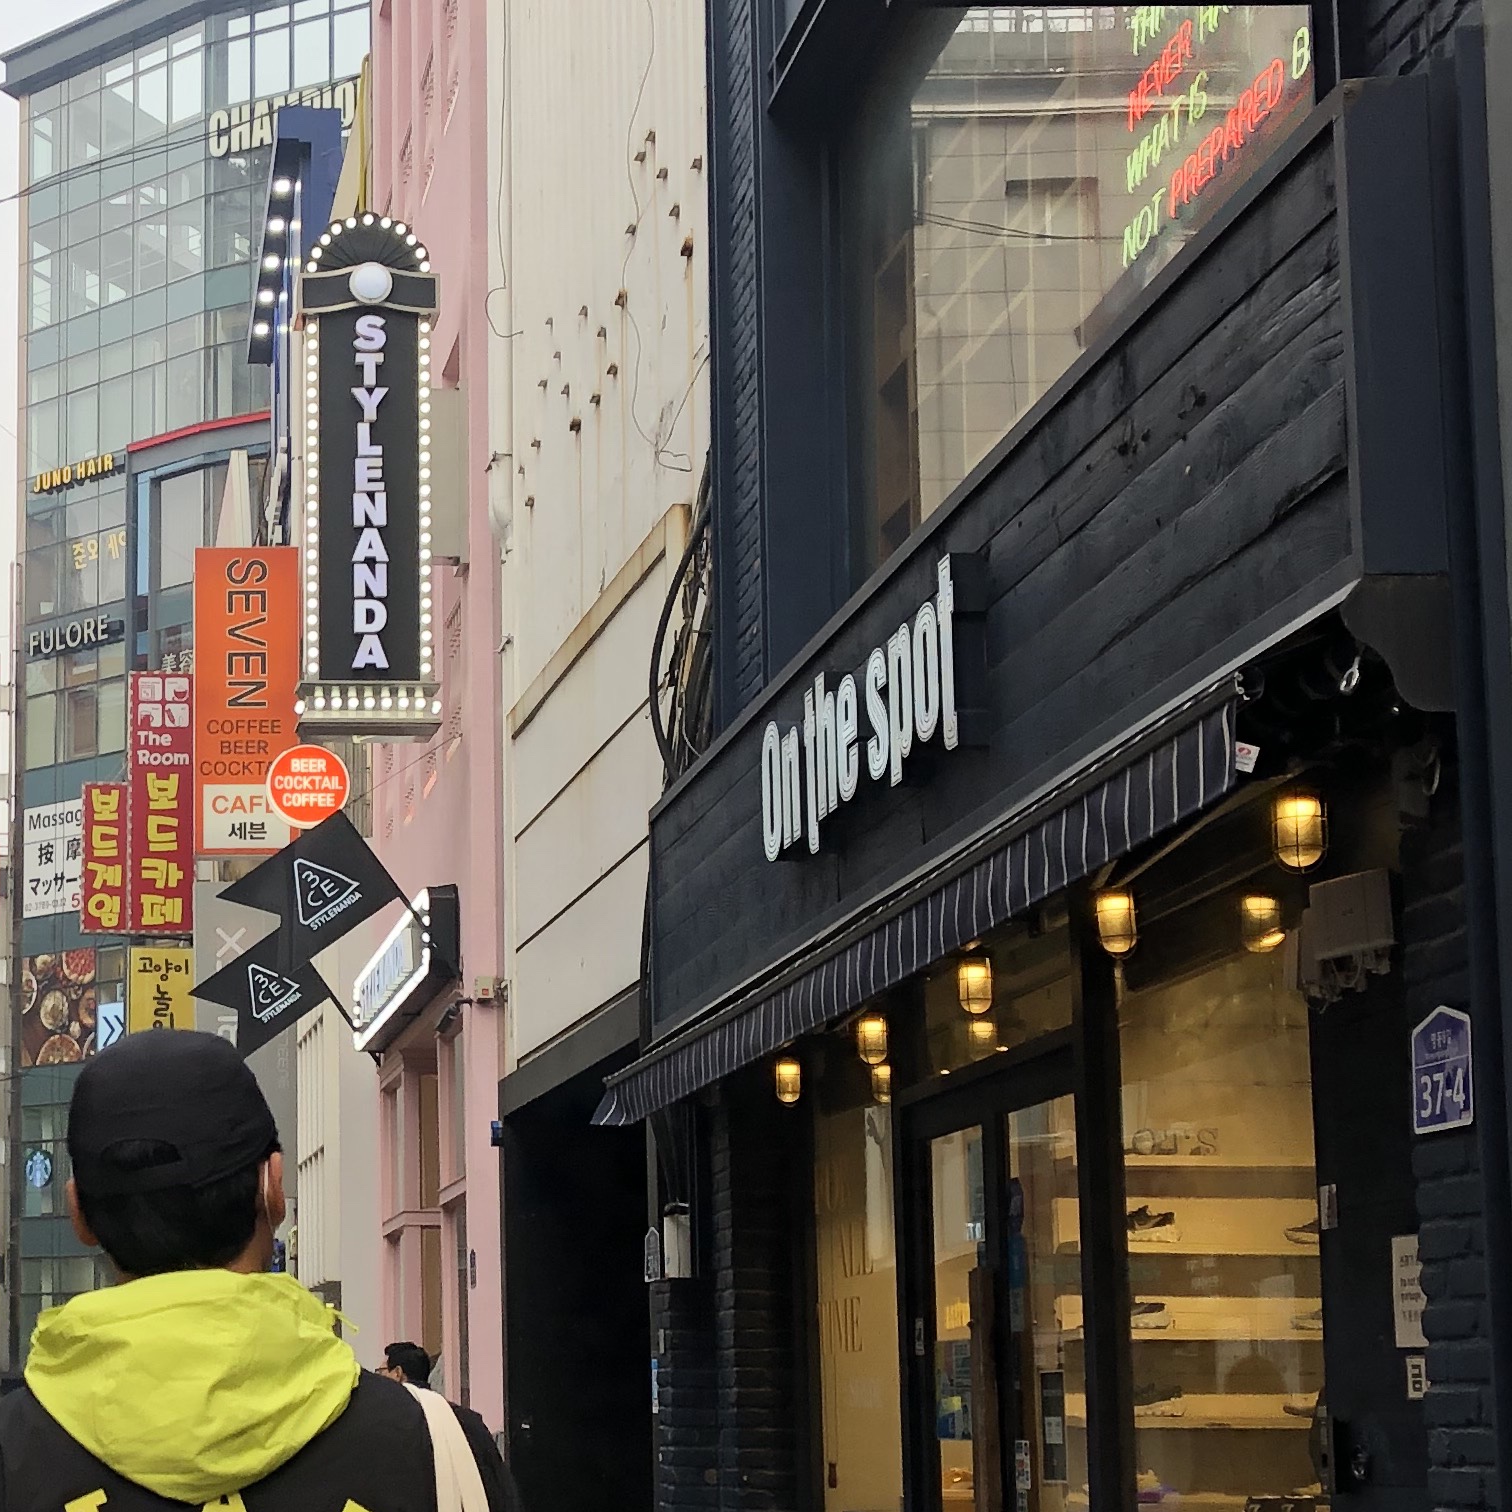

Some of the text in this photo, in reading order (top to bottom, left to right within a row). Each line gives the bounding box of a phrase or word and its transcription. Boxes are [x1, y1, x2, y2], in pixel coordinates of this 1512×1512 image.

[1128, 19, 1193, 132] NEVER
[1126, 94, 1187, 195] WHAT
[1188, 70, 1209, 127] IS
[1122, 187, 1167, 268] NOT
[1169, 58, 1285, 219] PREPARED
[33, 453, 114, 493] JUNO HAIR
[351, 313, 390, 671] STYLENANDA
[29, 614, 110, 657] FULORE
[226, 558, 268, 708] SEVEN
[803, 671, 860, 855] the
[865, 553, 959, 788] spot
[137, 730, 173, 747] The
[206, 719, 282, 735] COFFEE
[137, 750, 190, 766] Room
[220, 739, 269, 754] BEER
[290, 757, 327, 773] BEER
[274, 775, 344, 791] COCKTAIL
[282, 792, 336, 808] COFFEE
[28, 808, 82, 831] Massag
[228, 821, 268, 841] 세븐
[88, 788, 123, 928] 보드게임
[141, 772, 184, 926] 보드카페
[29, 872, 82, 897] マッサー
[309, 890, 363, 932] STYLENANDA
[137, 956, 190, 982] 고양이
[262, 990, 303, 1025] STYLENANDA
[1420, 1067, 1466, 1119] 37-4
